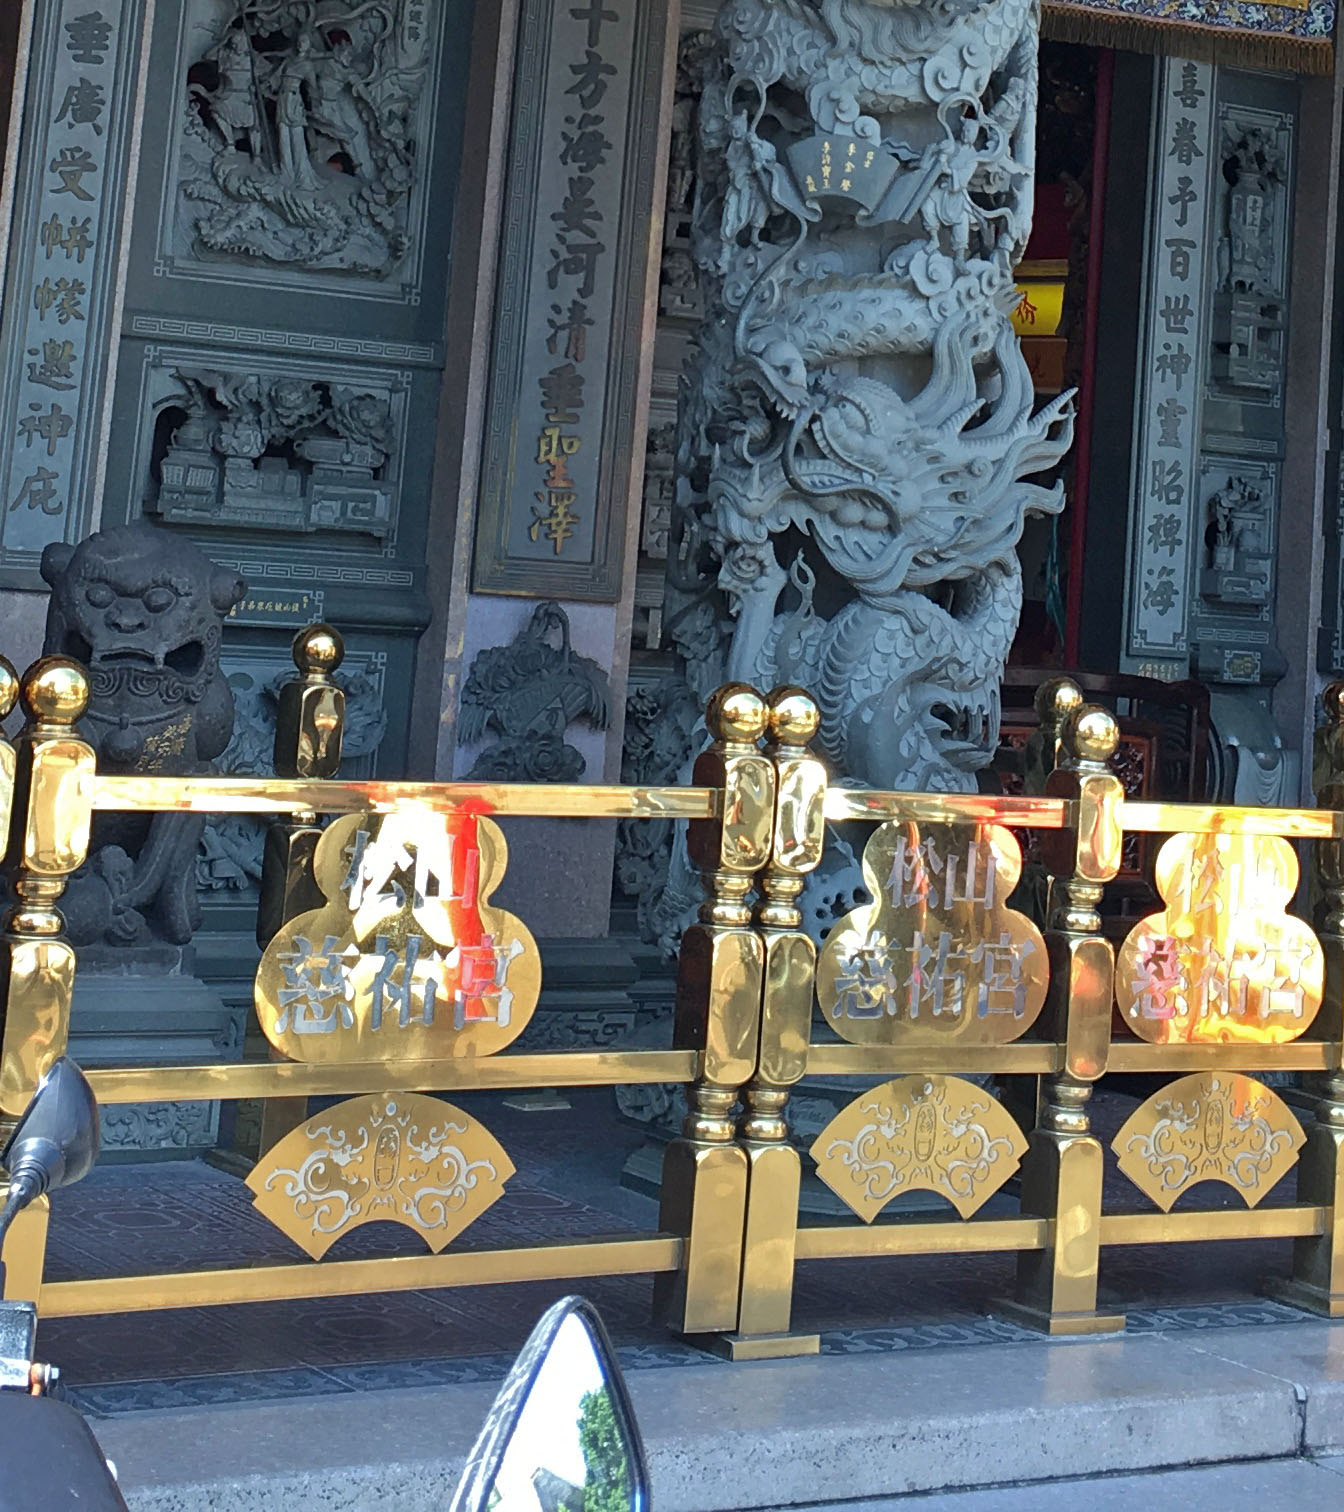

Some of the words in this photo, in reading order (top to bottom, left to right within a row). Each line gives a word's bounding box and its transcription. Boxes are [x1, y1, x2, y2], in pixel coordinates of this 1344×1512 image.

[887, 834, 998, 912] 松山
[274, 933, 525, 1032] 慈祐宮
[831, 931, 1038, 1021] 慈祐宮
[1130, 934, 1309, 1021] 慈祐宮
